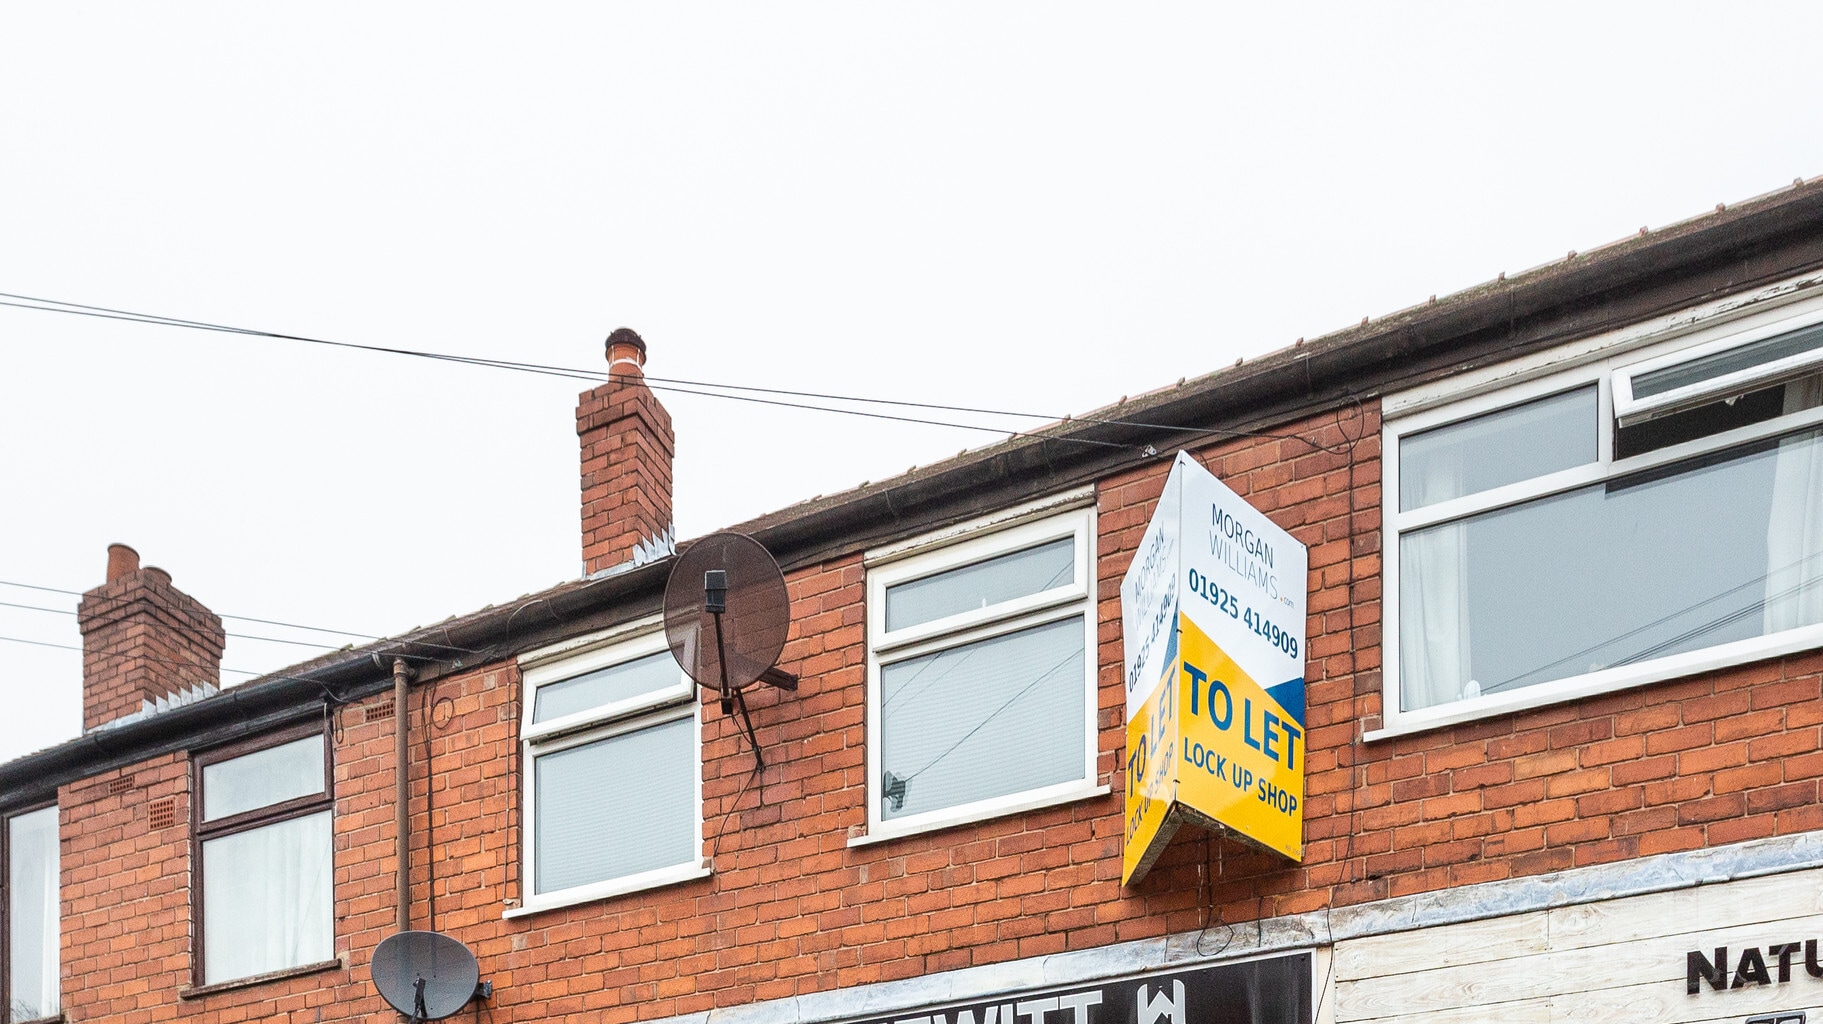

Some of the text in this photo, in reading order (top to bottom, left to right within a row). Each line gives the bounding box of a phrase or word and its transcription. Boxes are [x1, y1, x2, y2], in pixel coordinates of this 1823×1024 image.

[1212, 503, 1274, 569] MORGAN
[1188, 567, 1298, 660] 01925 414909
[1128, 664, 1176, 798] TO LET
[1183, 661, 1301, 770] TO LET
[1184, 736, 1298, 817] LOCK UP SHOP
[1126, 799, 1143, 847] LOCK
